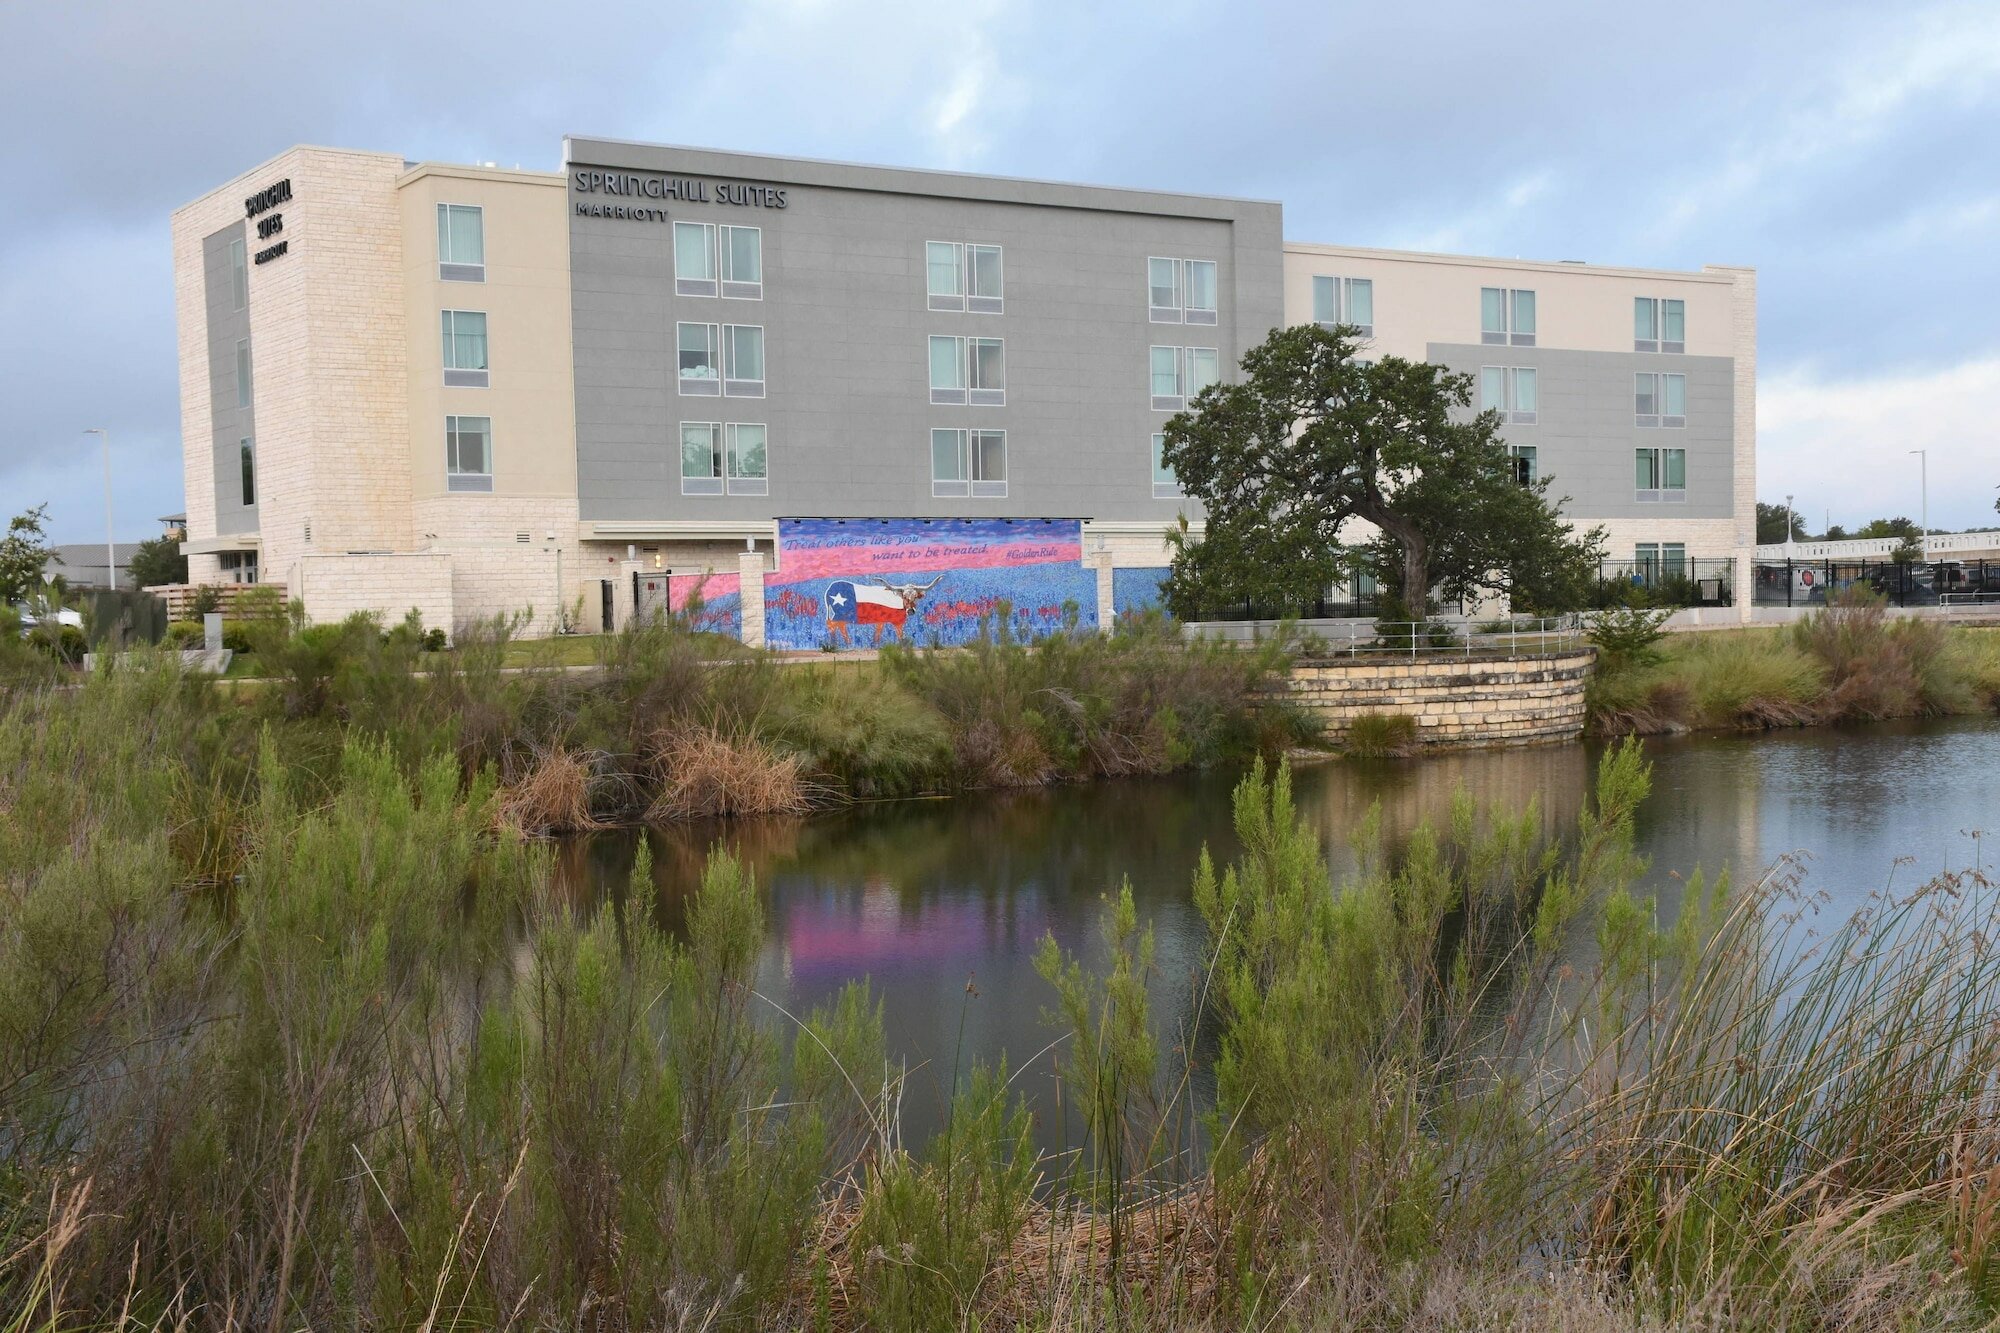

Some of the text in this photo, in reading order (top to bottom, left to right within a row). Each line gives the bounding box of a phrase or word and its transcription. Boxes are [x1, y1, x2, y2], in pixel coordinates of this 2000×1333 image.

[575, 171, 789, 209] SPRINGHILL SUITES
[576, 202, 669, 222] MARRIOTT
[784, 535, 920, 551] Treat others like you
[872, 550, 904, 561] want
[908, 550, 921, 559] to
[925, 547, 939, 558] be
